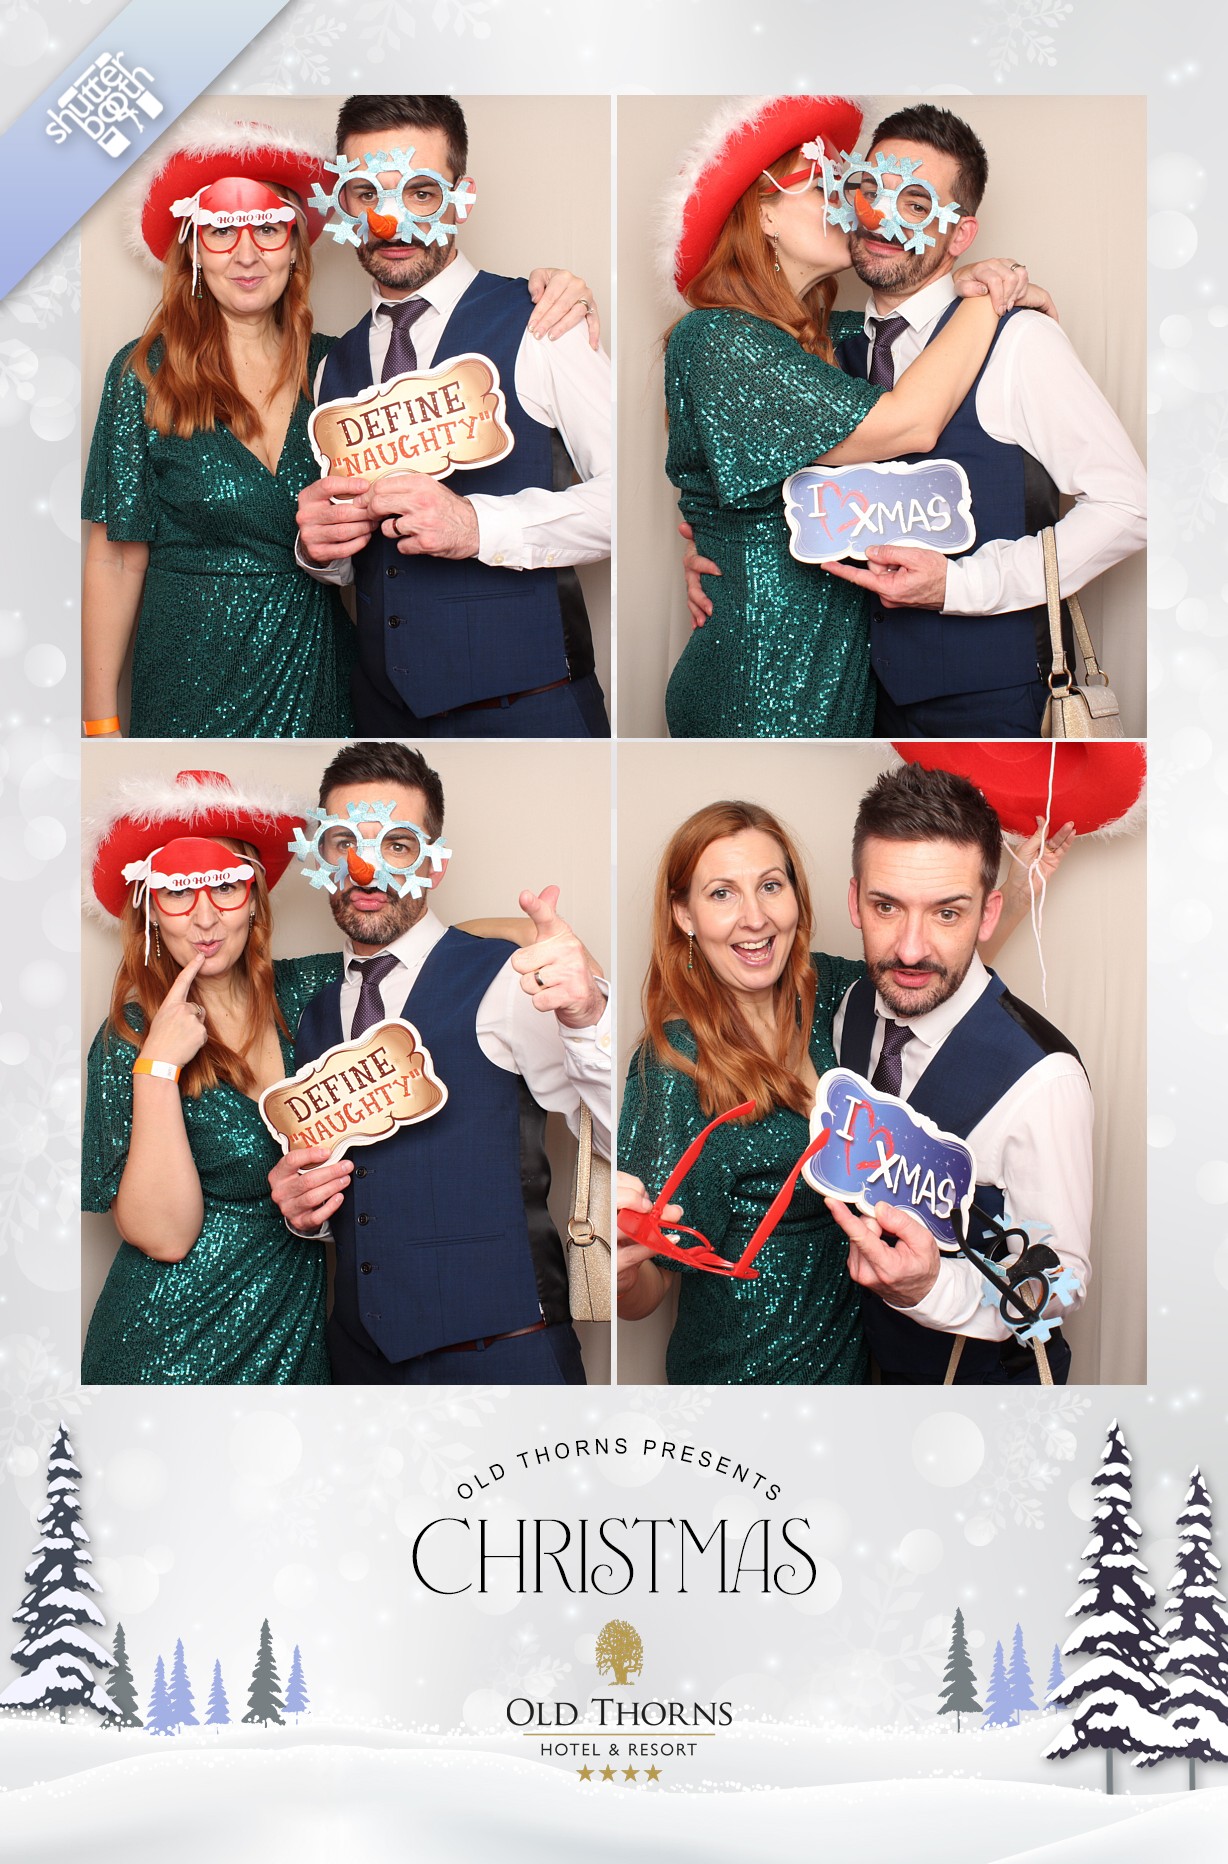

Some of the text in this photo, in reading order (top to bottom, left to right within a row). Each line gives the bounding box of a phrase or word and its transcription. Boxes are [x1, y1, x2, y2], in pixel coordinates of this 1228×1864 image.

[217, 212, 273, 224] HO HO HO
[336, 381, 466, 447] DEFINE
[807, 483, 952, 537] I XMAS
[172, 872, 231, 887] HO HO HO
[284, 1046, 396, 1123] DEFINE
[836, 1095, 955, 1219] I XMAS
